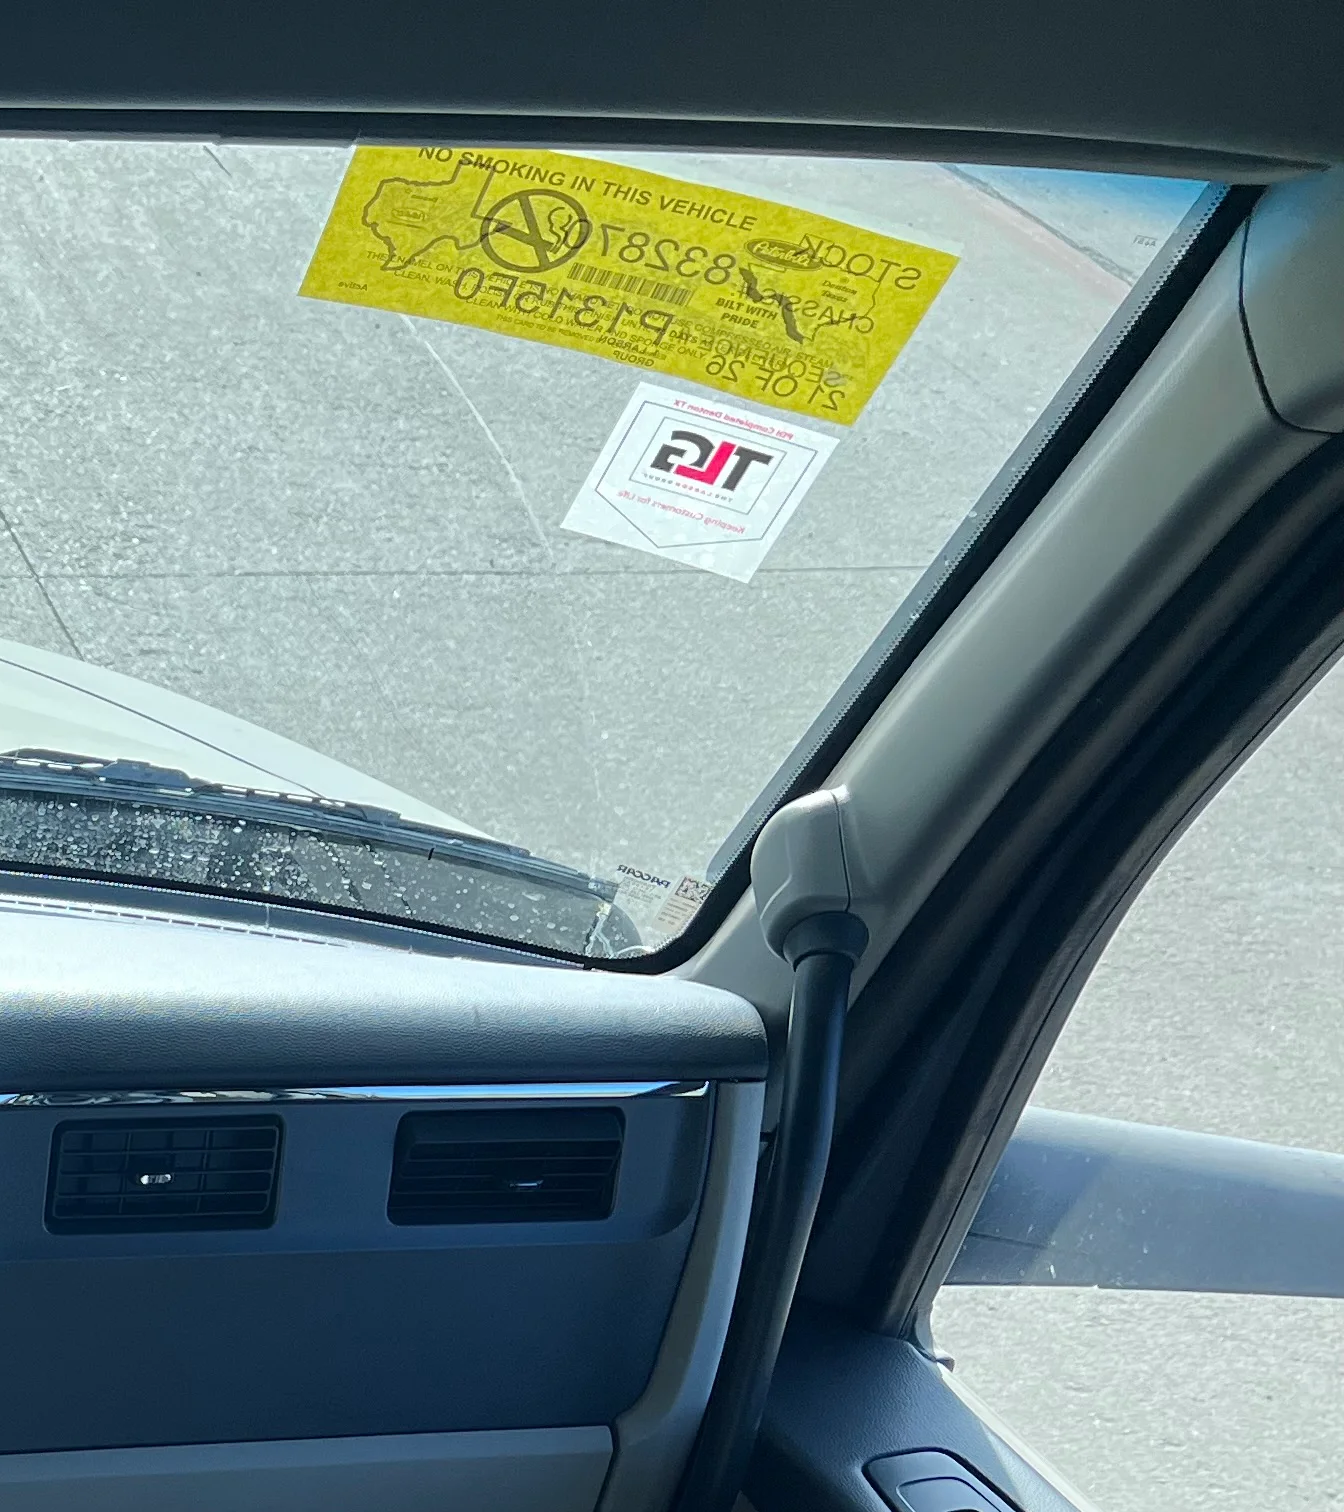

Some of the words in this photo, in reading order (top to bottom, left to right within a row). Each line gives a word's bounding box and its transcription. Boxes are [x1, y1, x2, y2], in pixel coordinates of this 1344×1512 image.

[418, 147, 453, 163] NO
[459, 151, 565, 187] SMOKING
[570, 175, 596, 192] IN
[602, 180, 652, 206] THIS
[659, 195, 758, 232] VEHICLE
[715, 297, 744, 311] BILT
[745, 305, 778, 321] WITH
[721, 312, 759, 329] PRIDE
